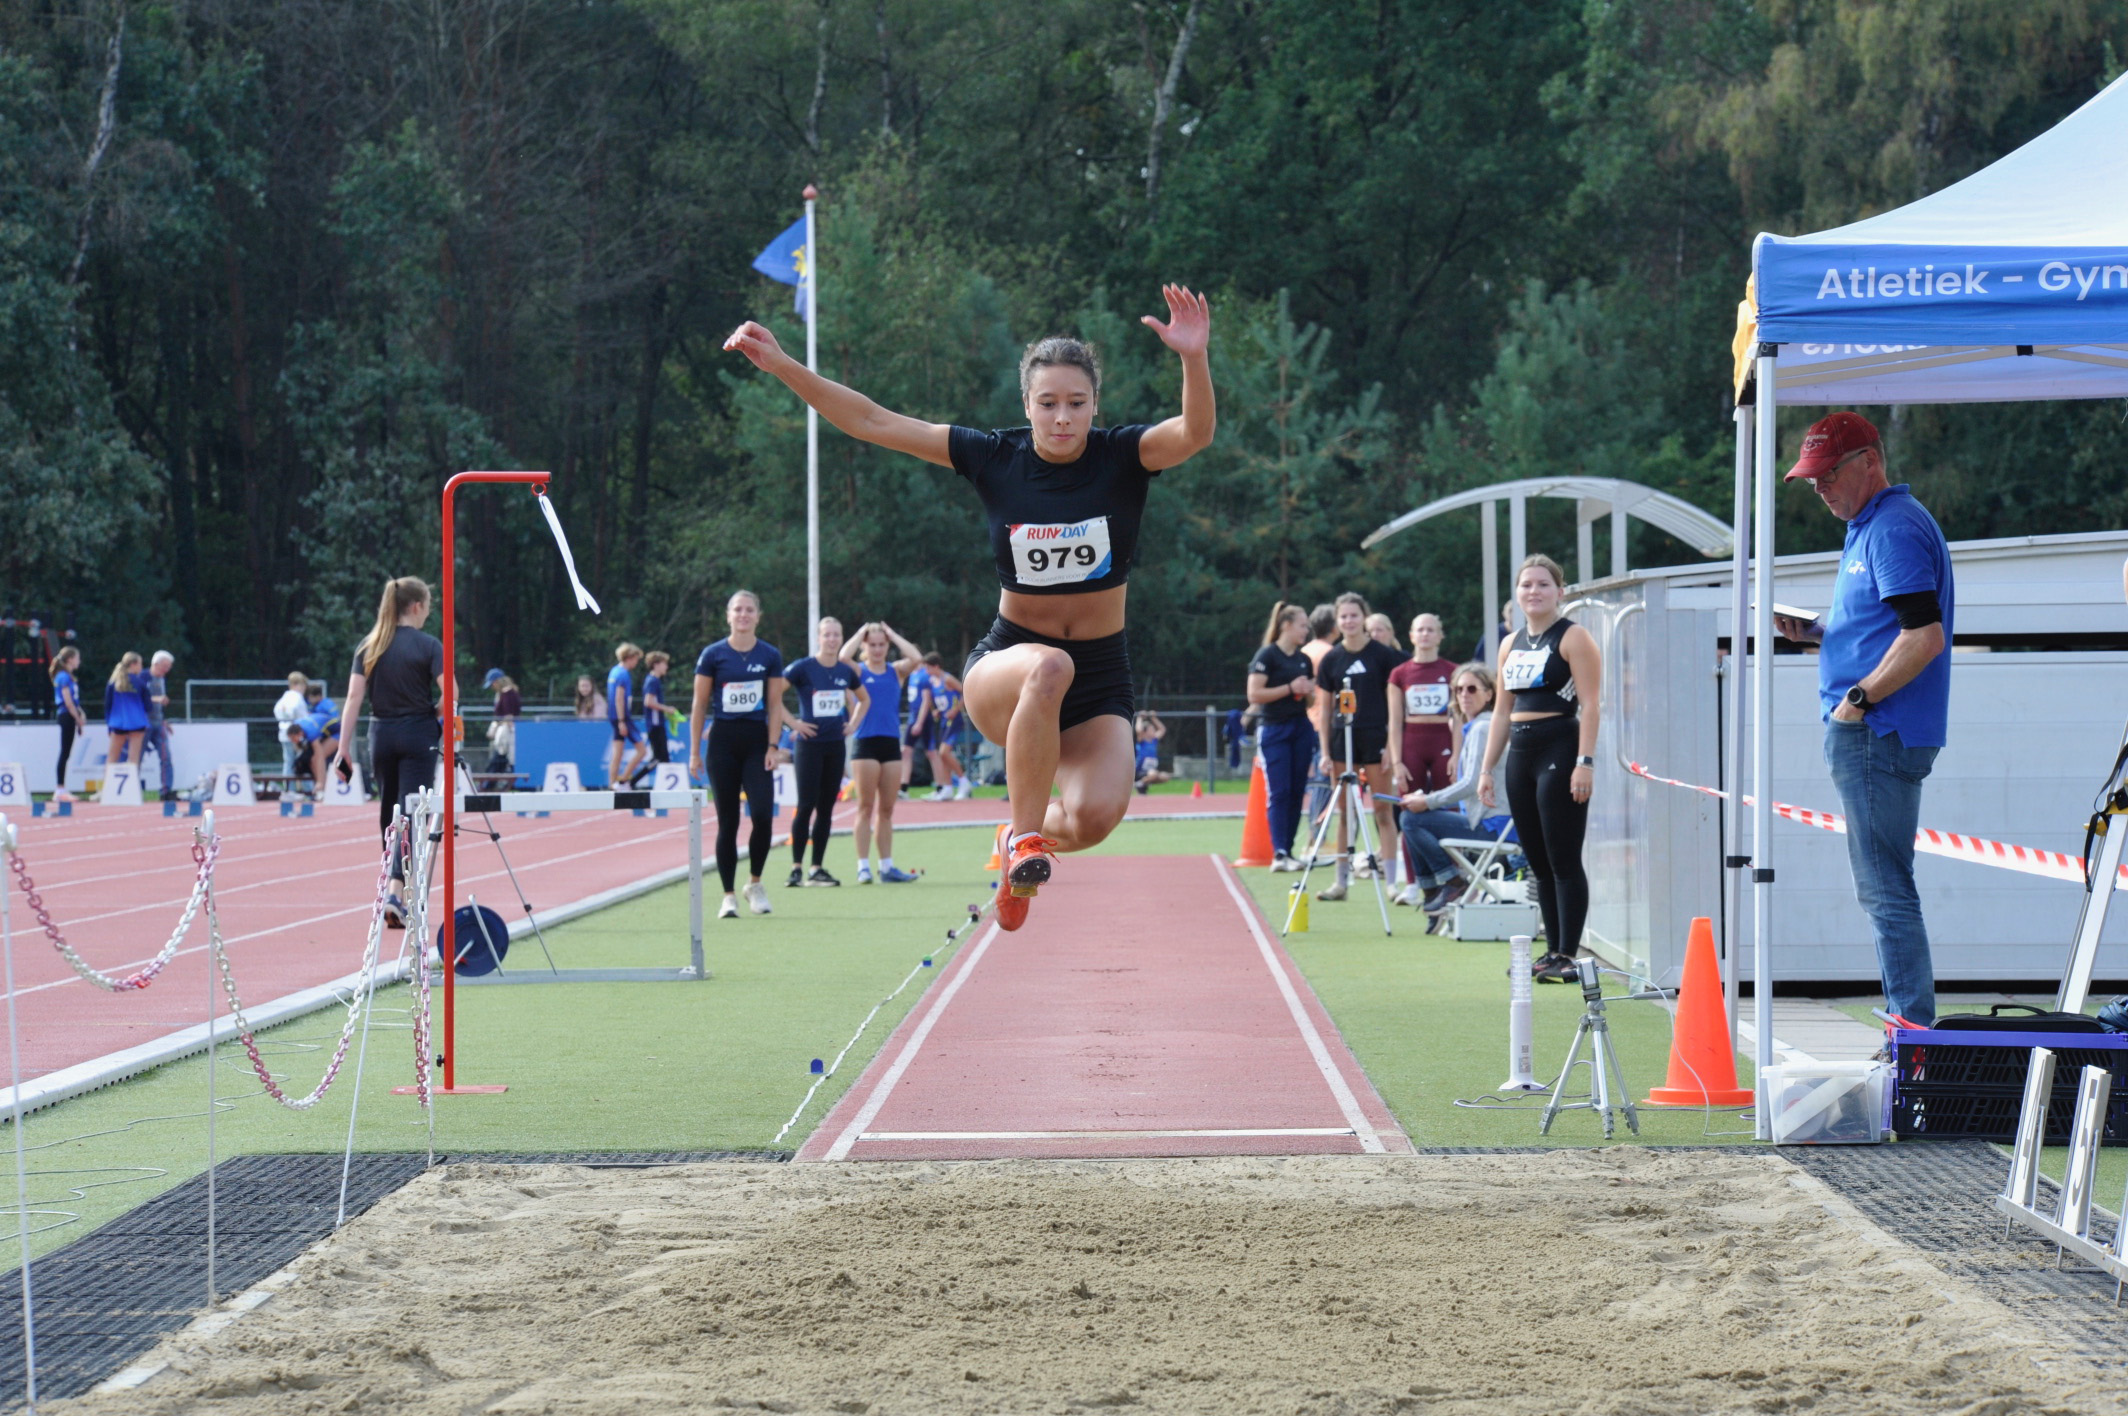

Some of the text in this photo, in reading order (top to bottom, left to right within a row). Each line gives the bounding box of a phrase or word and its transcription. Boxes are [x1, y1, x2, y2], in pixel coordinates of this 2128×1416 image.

[1816, 264, 1989, 300] Atletiek
[2002, 275, 2023, 283] -
[1027, 544, 1096, 573] 979
[1506, 664, 1535, 679] 977
[730, 692, 757, 705] 980
[819, 700, 841, 710] 975
[1413, 695, 1442, 708] 332
[0, 773, 14, 795] 8
[114, 774, 129, 795] 7
[226, 773, 241, 795] 6
[555, 773, 569, 792] 3
[665, 773, 679, 790] 2
[773, 774, 783, 795] 1
